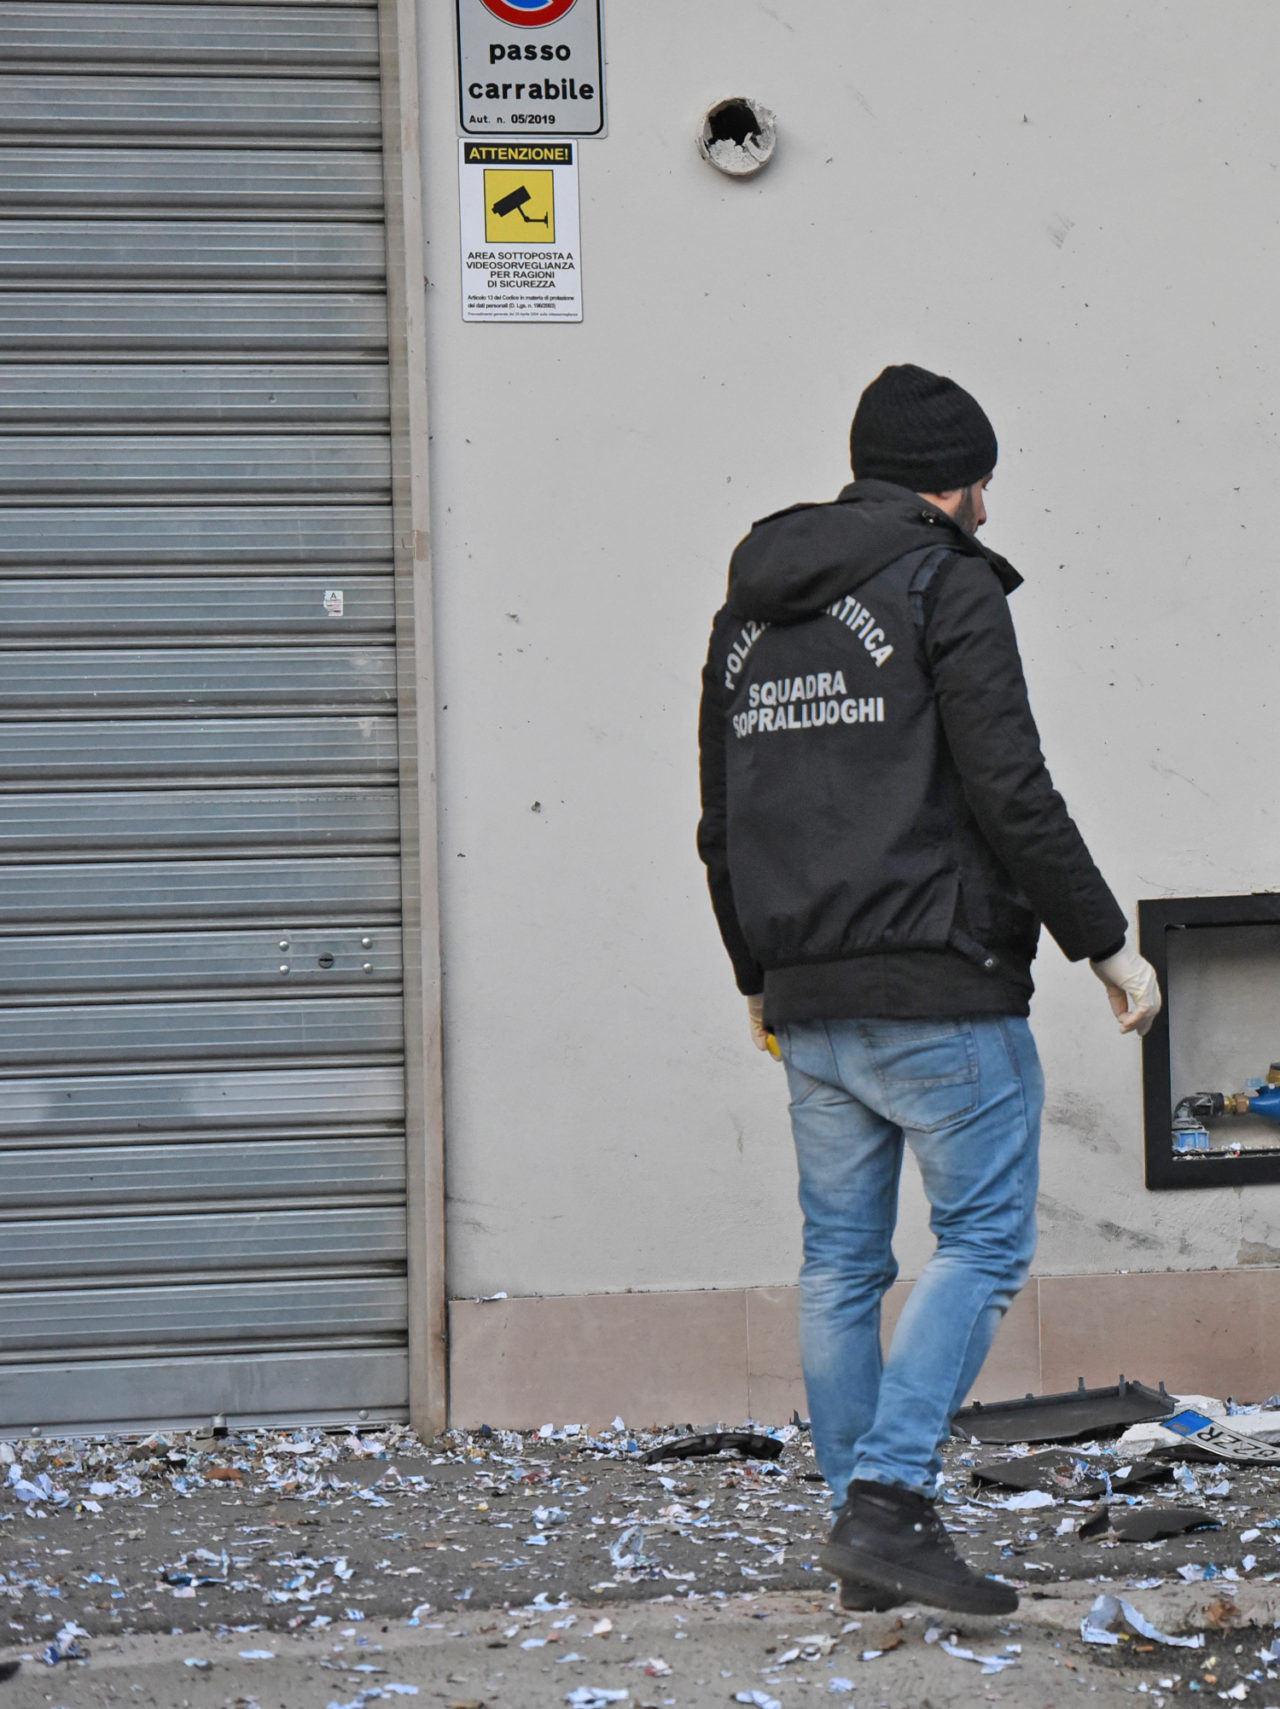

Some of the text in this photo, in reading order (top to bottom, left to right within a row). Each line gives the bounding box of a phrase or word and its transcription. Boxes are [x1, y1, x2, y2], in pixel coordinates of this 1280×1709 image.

[489, 43, 571, 64] passo
[468, 78, 594, 100] carrabile
[469, 114, 556, 124] Aut. n. 05/2019
[468, 147, 569, 160] ATTENZIONE!
[467, 252, 574, 260] AREA SOTTOPOSTA A
[466, 261, 575, 270] VIDEOSORVEGLIANZA
[490, 270, 555, 279] PER RAGIONI
[487, 280, 556, 288] DI SICUREZZA
[749, 670, 847, 708] SQUADRA
[733, 697, 884, 738] SOPRALLUOGHI
